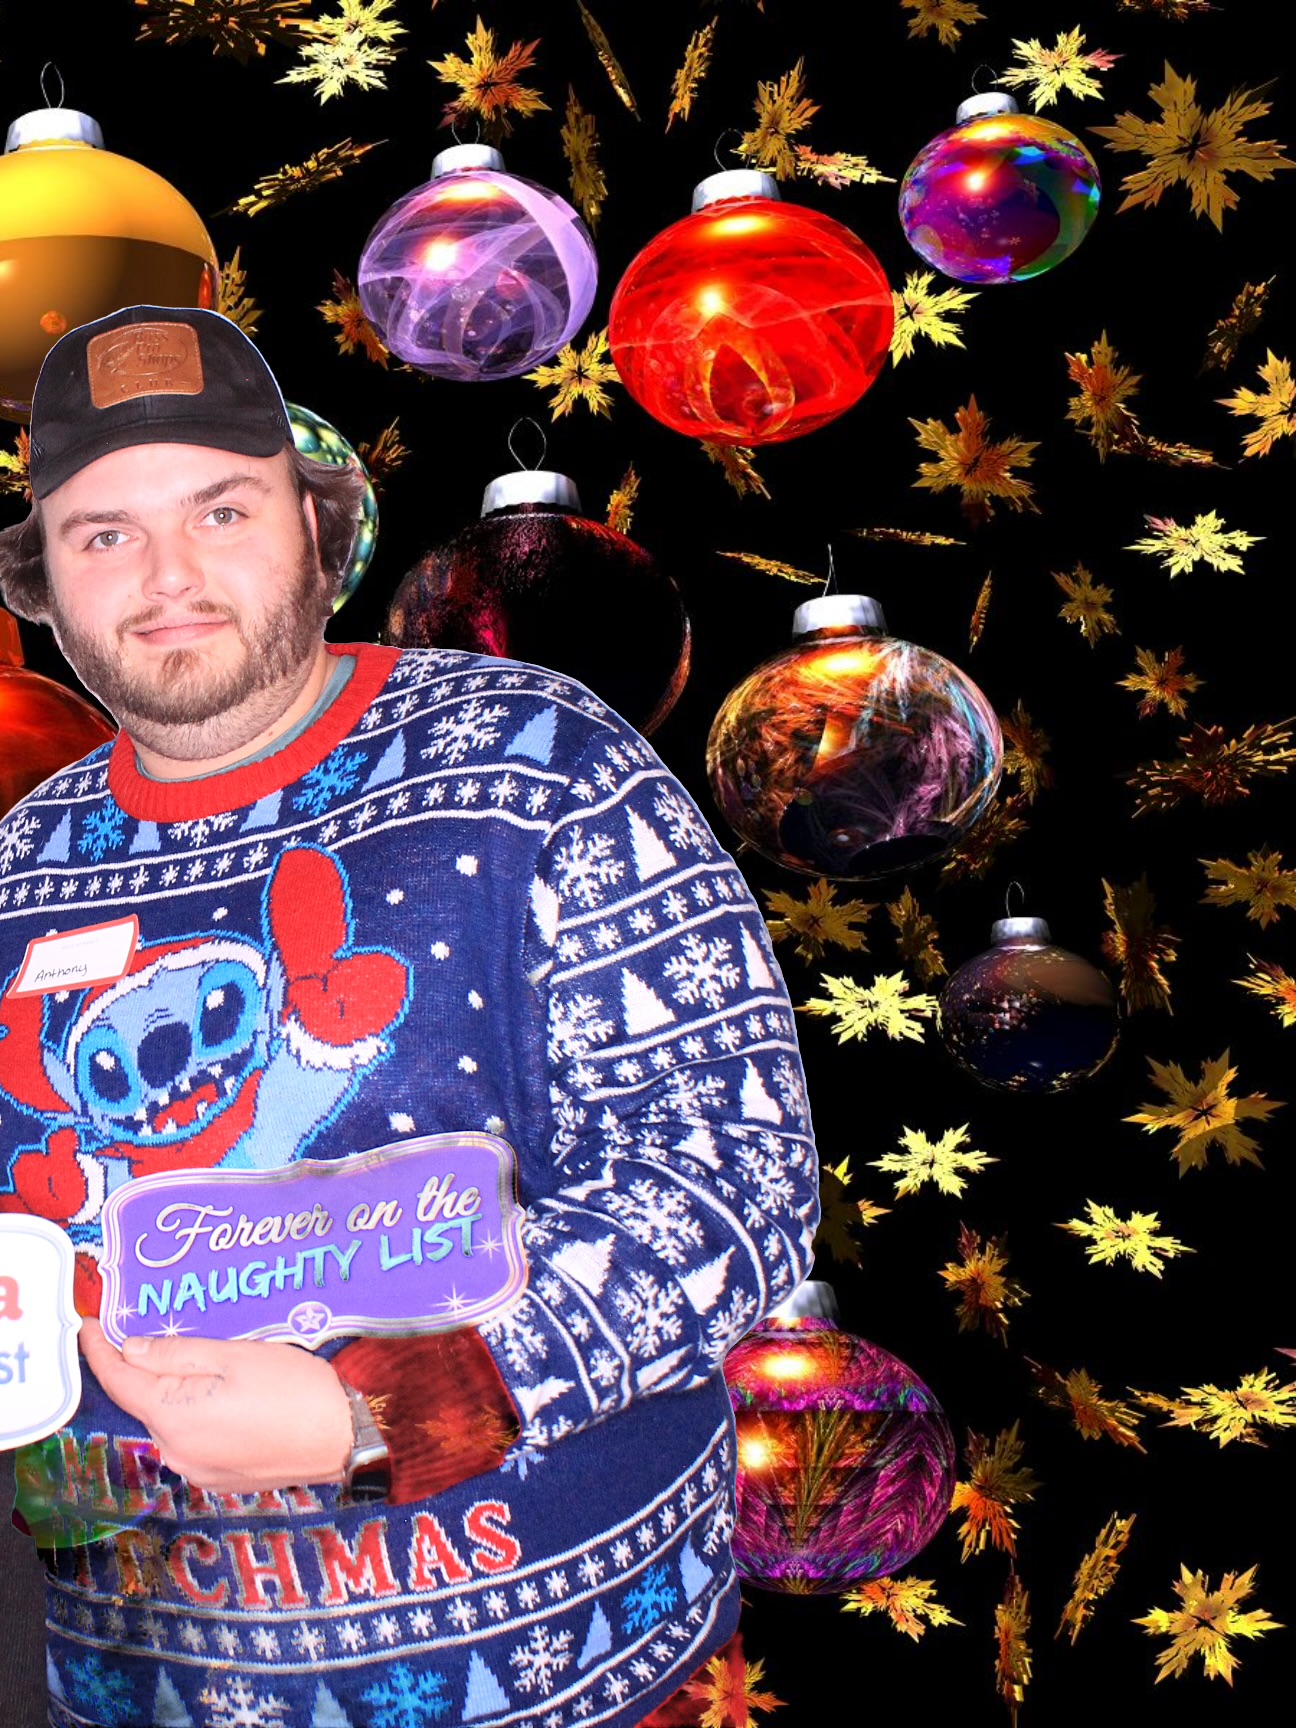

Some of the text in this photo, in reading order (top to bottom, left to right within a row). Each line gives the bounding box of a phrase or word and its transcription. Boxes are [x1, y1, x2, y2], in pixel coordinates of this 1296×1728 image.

[34, 964, 88, 982] Anthony
[135, 1173, 482, 1268] Forever on the
[137, 1214, 483, 1317] NAUGHTY LIST
